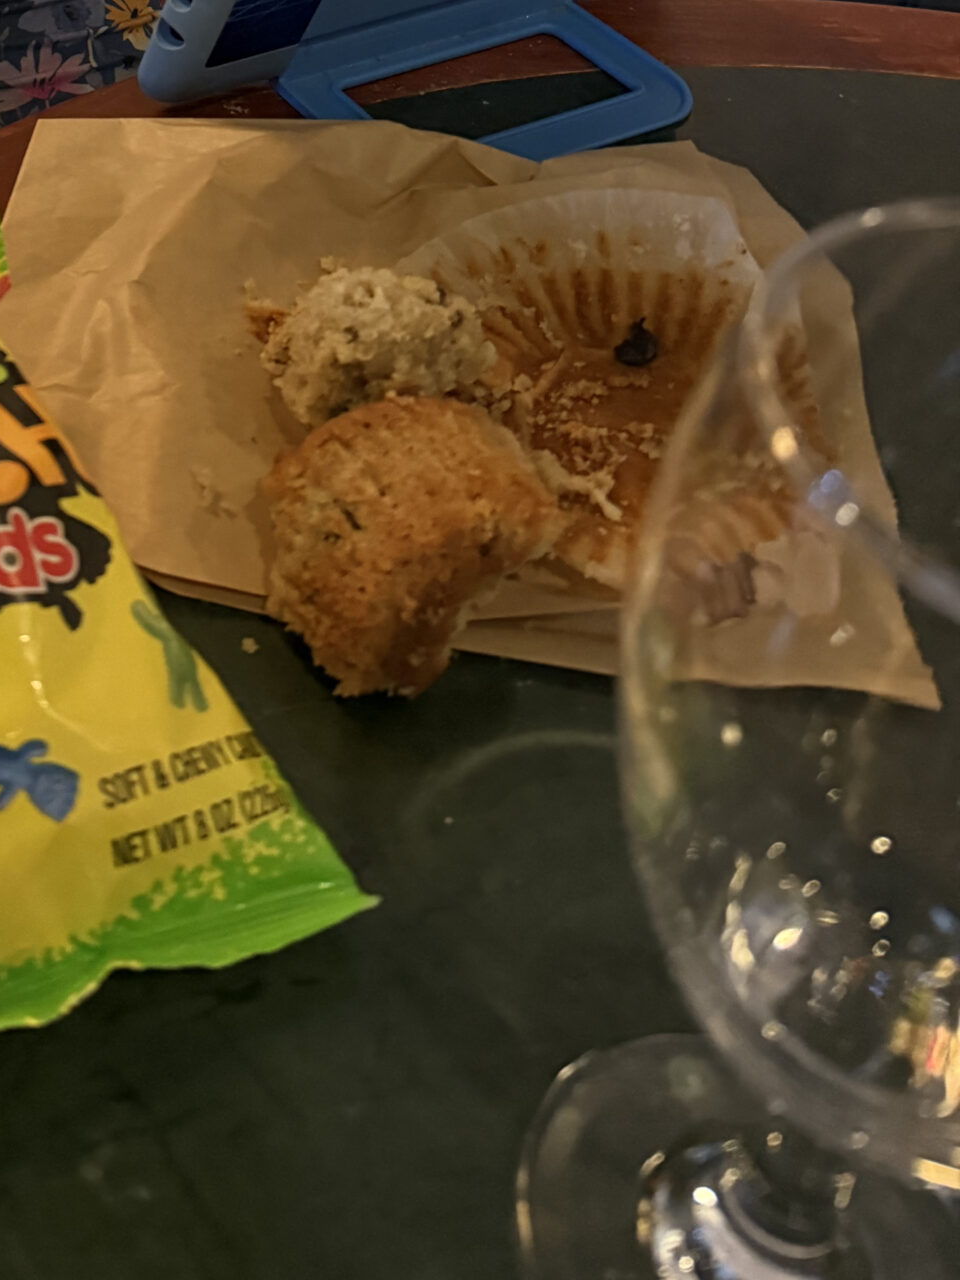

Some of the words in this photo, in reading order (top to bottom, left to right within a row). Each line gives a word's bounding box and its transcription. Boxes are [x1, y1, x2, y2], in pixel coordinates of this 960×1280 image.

[98, 764, 151, 810] SOFT
[151, 758, 170, 790] &
[169, 740, 233, 784] CHEWY
[111, 829, 153, 868] NET
[154, 814, 191, 853] WT
[193, 809, 211, 841] 8
[209, 797, 241, 834] OZ
